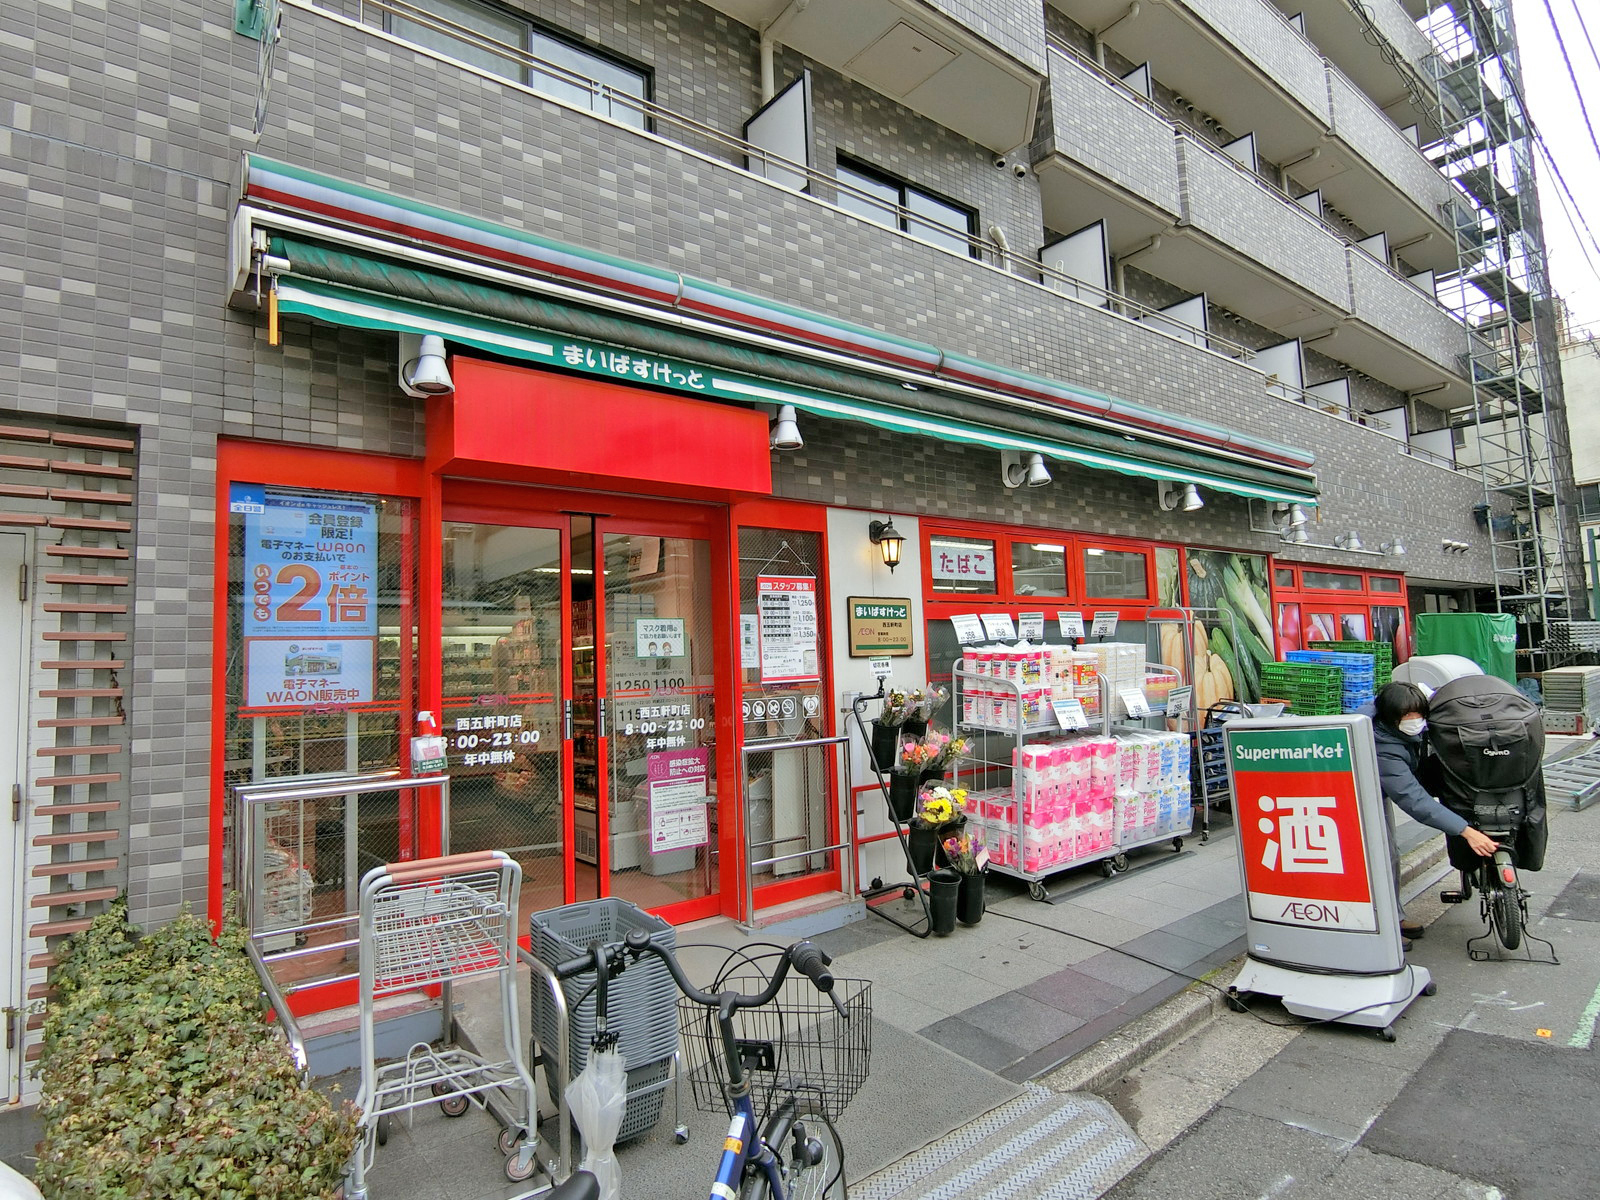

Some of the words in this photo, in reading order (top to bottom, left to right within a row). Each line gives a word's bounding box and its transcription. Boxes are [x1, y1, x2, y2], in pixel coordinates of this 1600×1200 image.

[563, 344, 705, 389] まいばすけっと
[308, 512, 364, 528] 会員登録
[321, 527, 353, 540] 限定!
[282, 552, 346, 562] のお支払いで
[940, 552, 986, 574] たばこ
[329, 572, 370, 582] ポイント
[255, 566, 270, 620] いつでも
[856, 606, 906, 617] まいばすけっと
[284, 678, 340, 690] 電子マネー
[616, 680, 650, 690] 1250
[654, 678, 684, 689] 1100
[266, 688, 360, 702] WAON販売中
[640, 704, 690, 718] 西五軒町店
[456, 714, 522, 731] 西五軒町店
[646, 735, 686, 750] 年中無休
[464, 750, 516, 766] 年中無休
[1236, 742, 1344, 761] Supermarket
[1258, 796, 1344, 874] 酒
